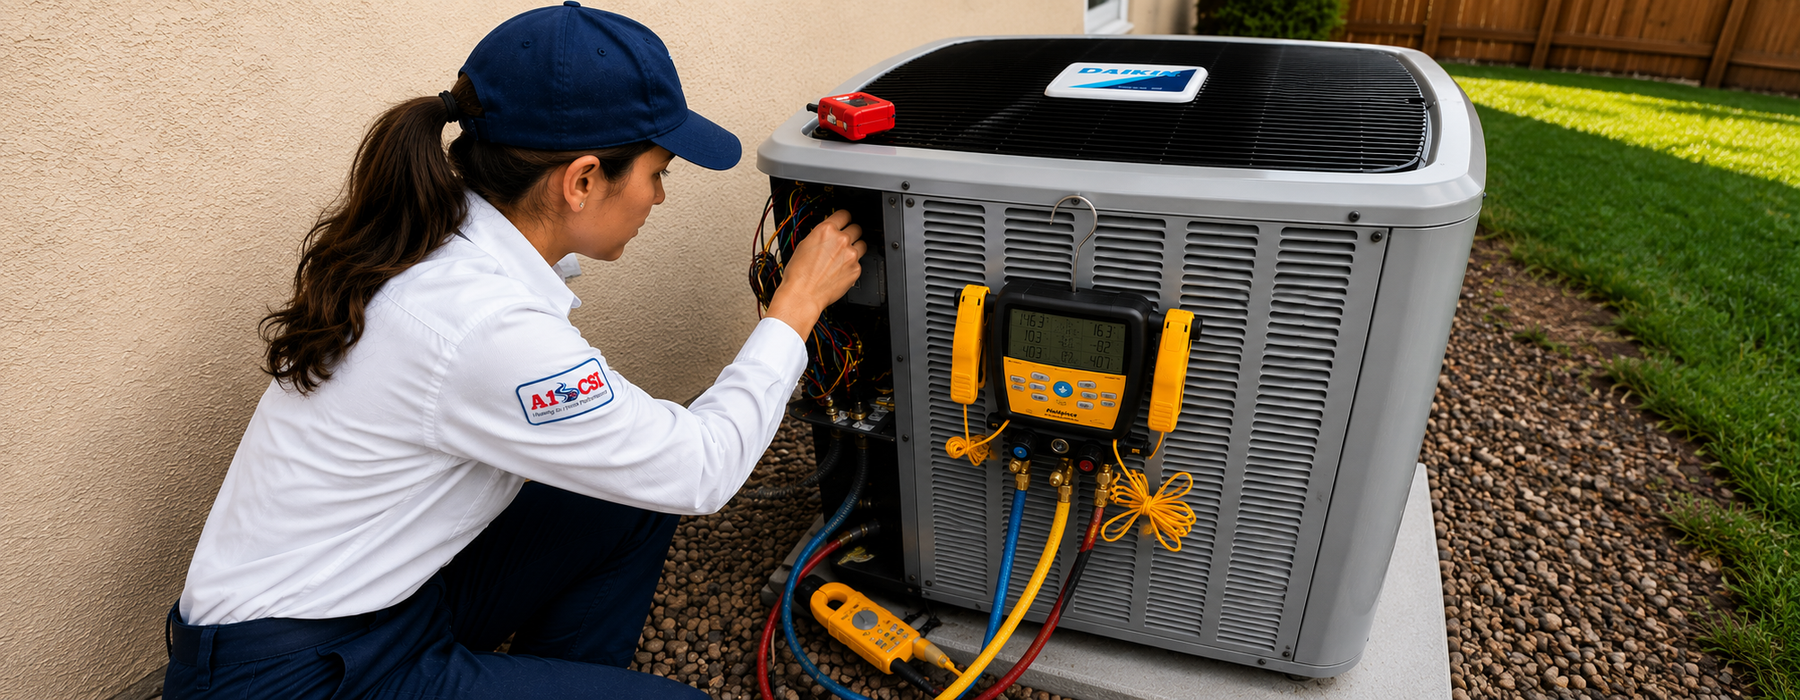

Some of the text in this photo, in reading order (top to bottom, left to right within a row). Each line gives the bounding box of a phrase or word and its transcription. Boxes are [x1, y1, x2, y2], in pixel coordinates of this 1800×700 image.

[1077, 67, 1182, 78] DAIKIN
[1024, 329, 1043, 344] 103
[1022, 345, 1043, 360] 403
[1089, 355, 1111, 370] 407
[531, 389, 560, 411] A1
[577, 371, 605, 395] CSI
